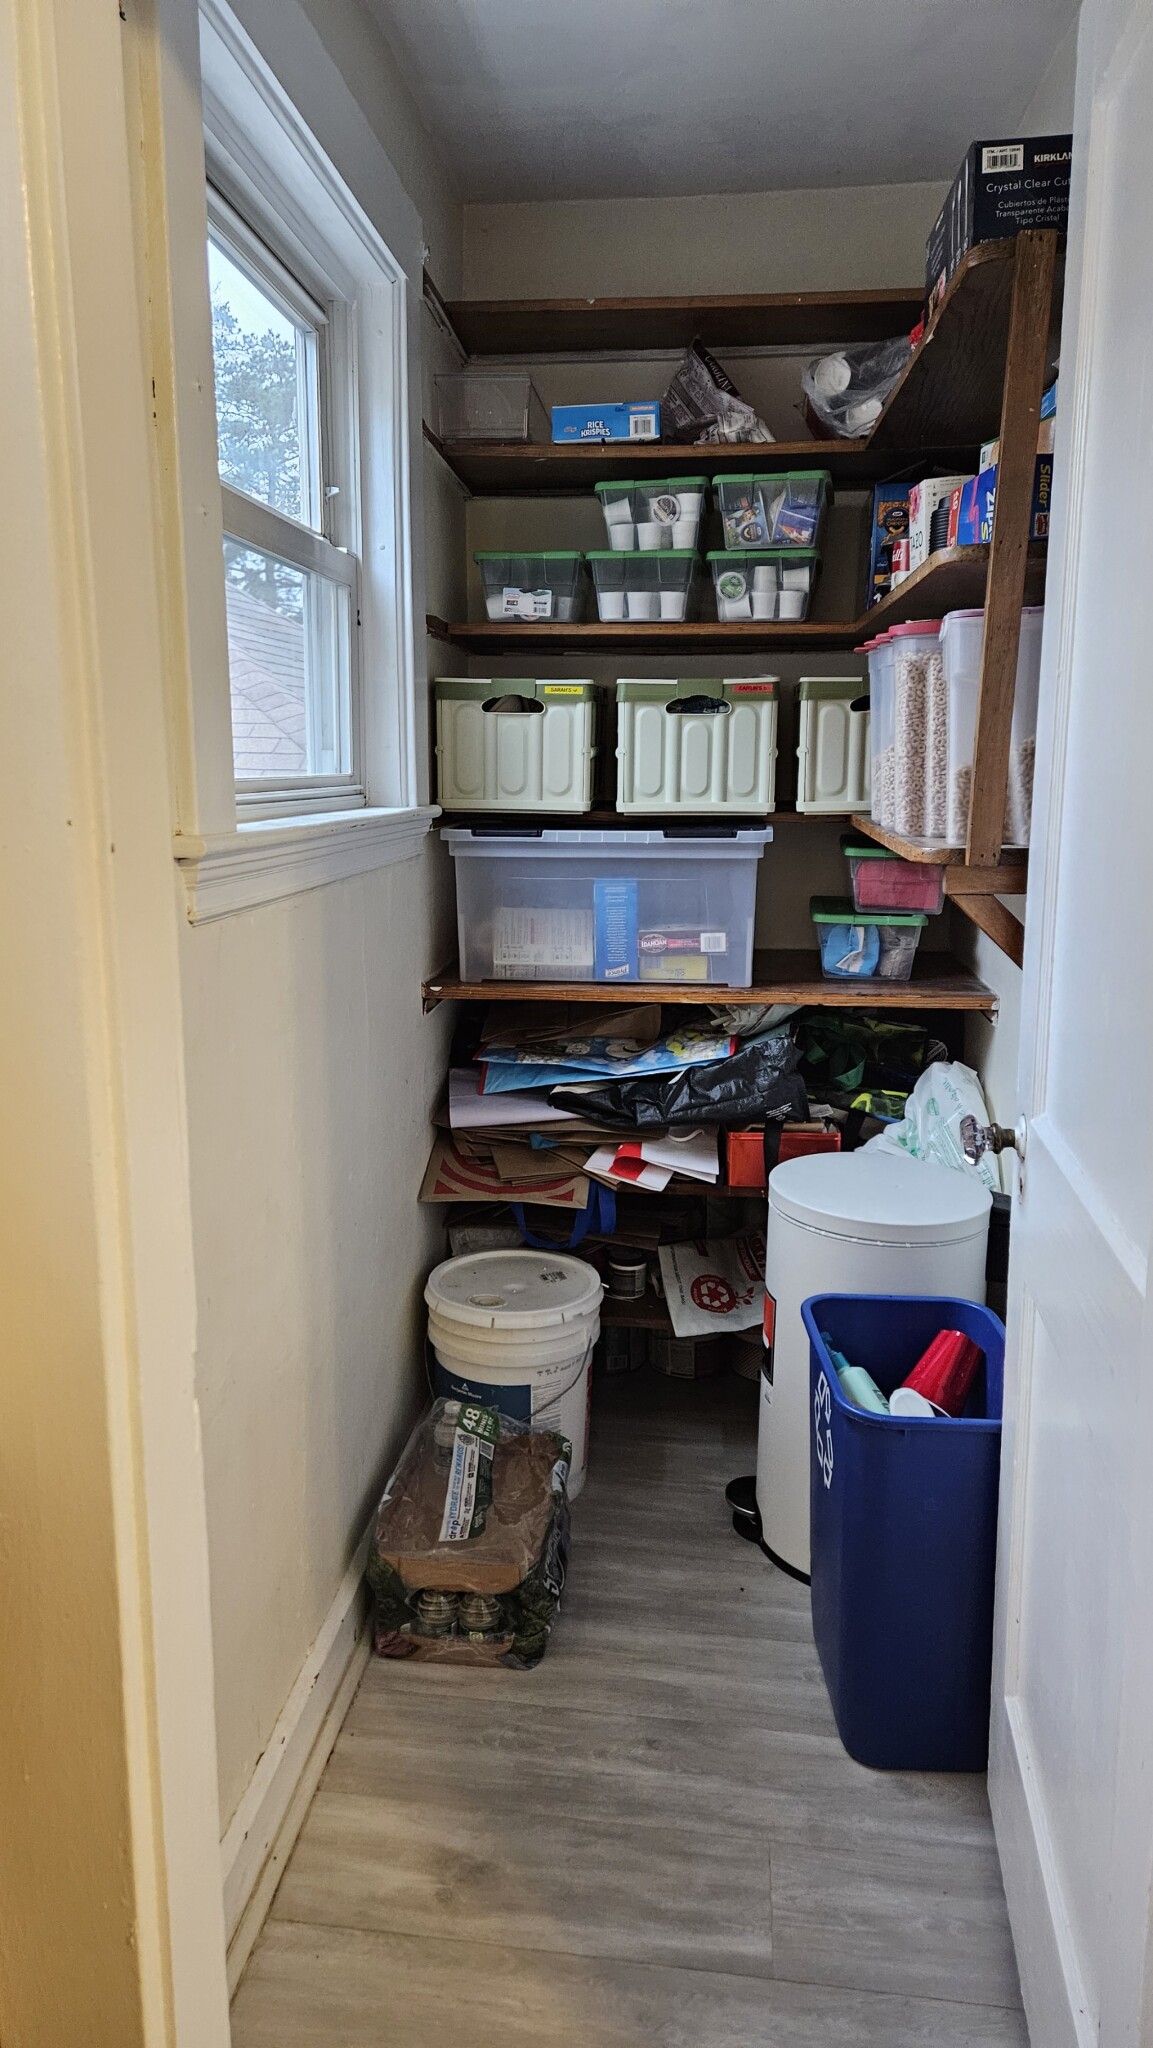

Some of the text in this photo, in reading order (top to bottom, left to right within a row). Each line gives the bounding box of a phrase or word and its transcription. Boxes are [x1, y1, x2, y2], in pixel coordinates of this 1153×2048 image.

[986, 180, 1021, 194] Crystal
[1024, 179, 1051, 189] Clear
[998, 199, 1036, 209] Cubiertos
[1037, 197, 1047, 205] de
[995, 206, 1045, 218] Transparente
[1015, 213, 1060, 226] Tipo Cristal
[587, 421, 604, 429] RICE
[580, 428, 611, 437] KRISPIES
[1039, 463, 1051, 508] Slider
[641, 939, 667, 948] IDAHOAN
[462, 1408, 481, 1431] 48
[477, 1415, 489, 1434] MINIS
